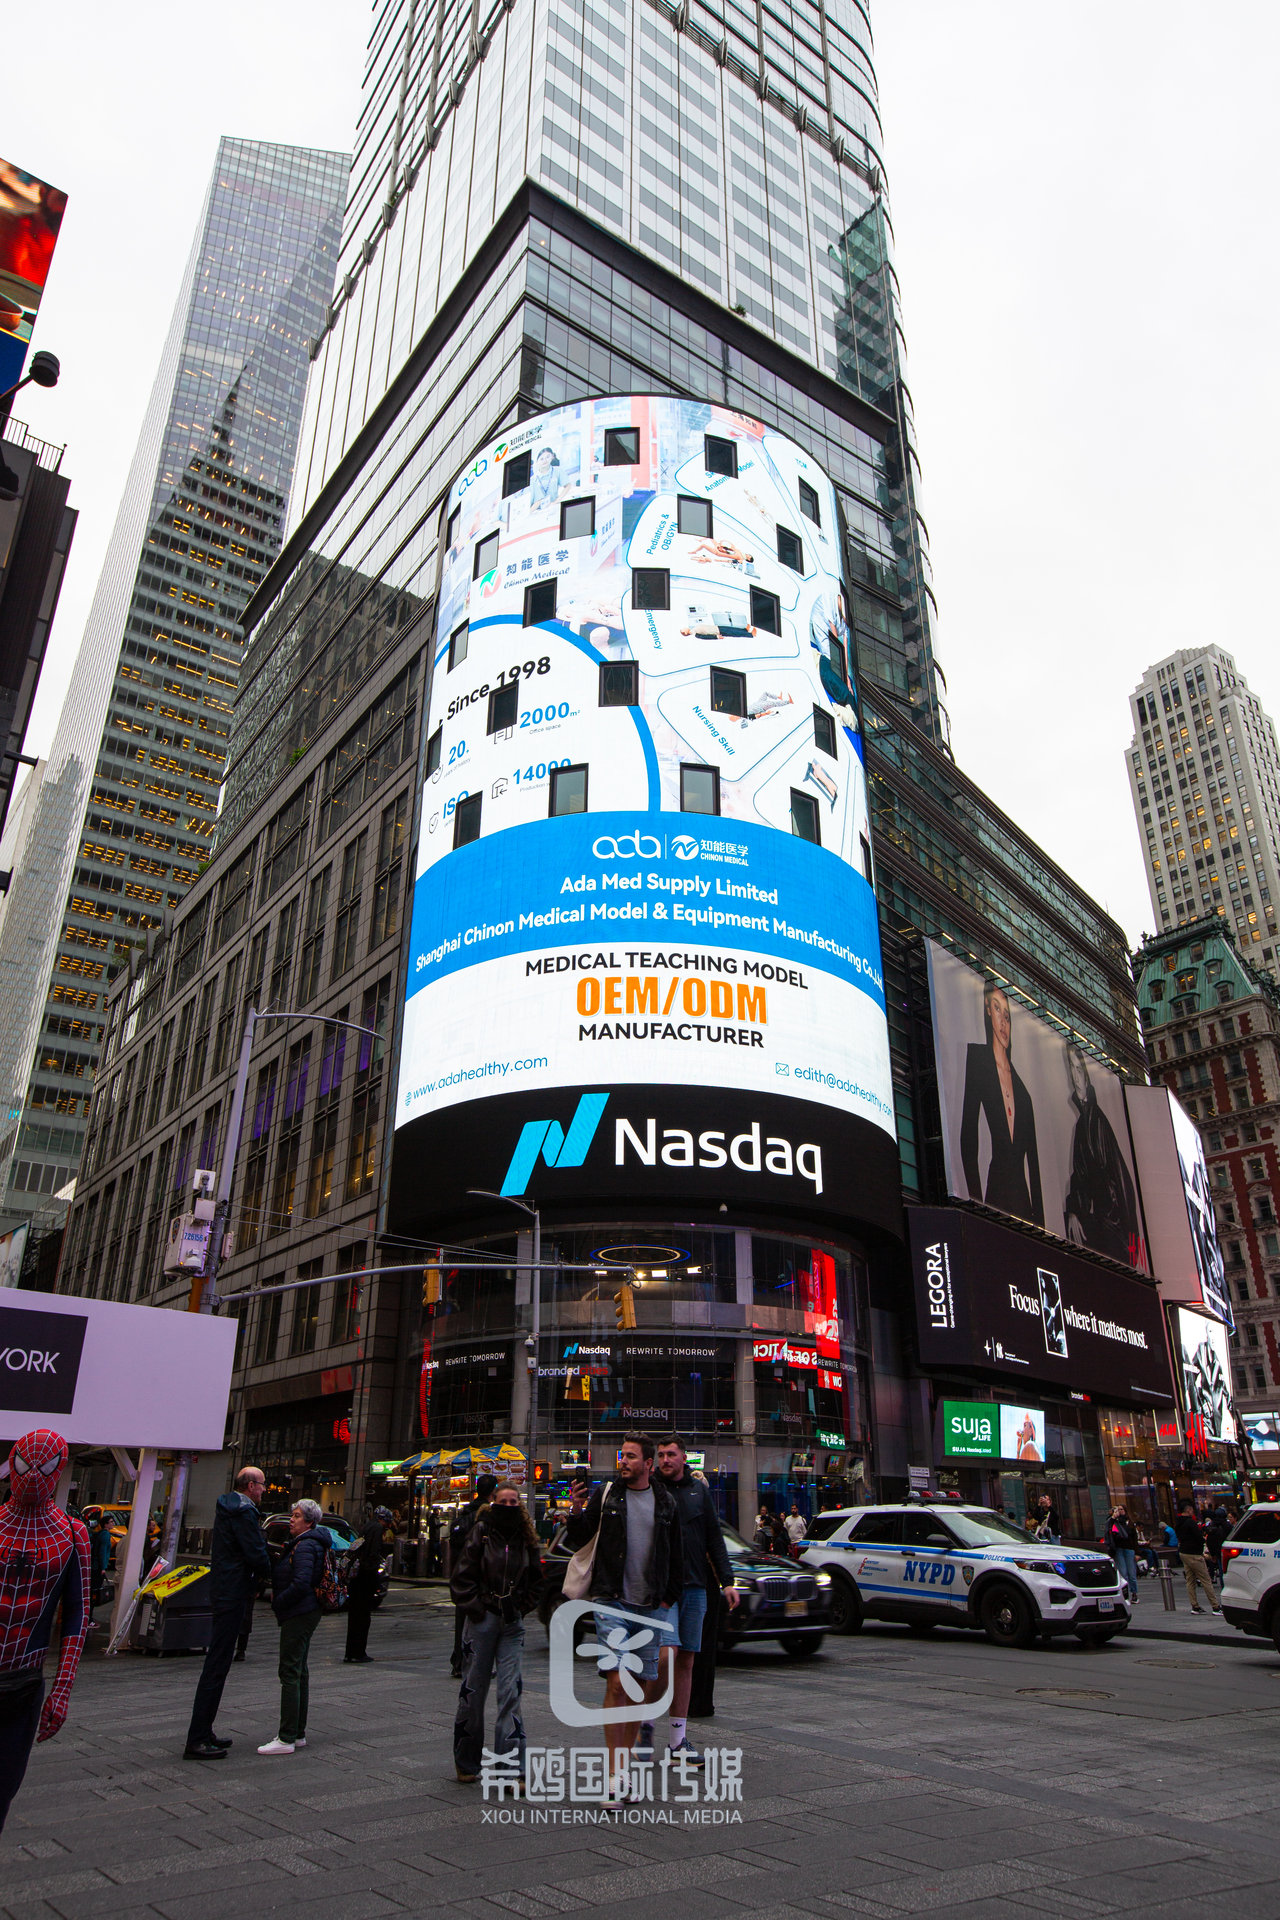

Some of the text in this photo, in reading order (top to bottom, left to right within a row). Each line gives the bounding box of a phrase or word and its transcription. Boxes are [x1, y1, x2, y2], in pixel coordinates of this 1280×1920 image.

[704, 474, 731, 492] Anatom
[646, 524, 666, 555] Pediatrics
[506, 549, 569, 577] 知能医学
[503, 566, 570, 589] Chinon Medical
[645, 609, 663, 650] Emergency
[447, 656, 551, 721] Since 1998
[692, 705, 736, 756] Nursing Skill
[700, 839, 749, 857] 知能医学
[700, 853, 749, 866] CHINON MEDICAL
[560, 872, 779, 905] Ada Med Supply Limited
[415, 932, 461, 973] Shanghai
[464, 920, 514, 946] Chinon
[519, 904, 585, 930] Medical
[590, 902, 647, 920] Model
[652, 902, 668, 920] &
[673, 903, 770, 932] Equipment
[773, 917, 862, 973] Manufacturing
[526, 951, 808, 990] MEDICAL TEACHING MODEL
[576, 976, 768, 1026] OEM/ODM
[578, 1022, 764, 1048] MANUFACTURER
[413, 1056, 548, 1100] www.adahealthy.com
[615, 1118, 824, 1195] Nasdaq
[925, 1242, 948, 1328] LEGORA
[1008, 1284, 1149, 1350] Focus where it matters most.
[445, 1356, 467, 1366] REWRITE
[470, 1352, 506, 1362] TOMORROW
[579, 1346, 716, 1356] Nasdaq REWRITE TOMORROW
[623, 1407, 668, 1420] Nasdaq
[951, 1417, 992, 1441] suja
[978, 1434, 992, 1442] LIFE
[1159, 1424, 1176, 1436] H&M
[983, 1554, 1005, 1562] POLICE
[903, 1560, 956, 1586] NYPD
